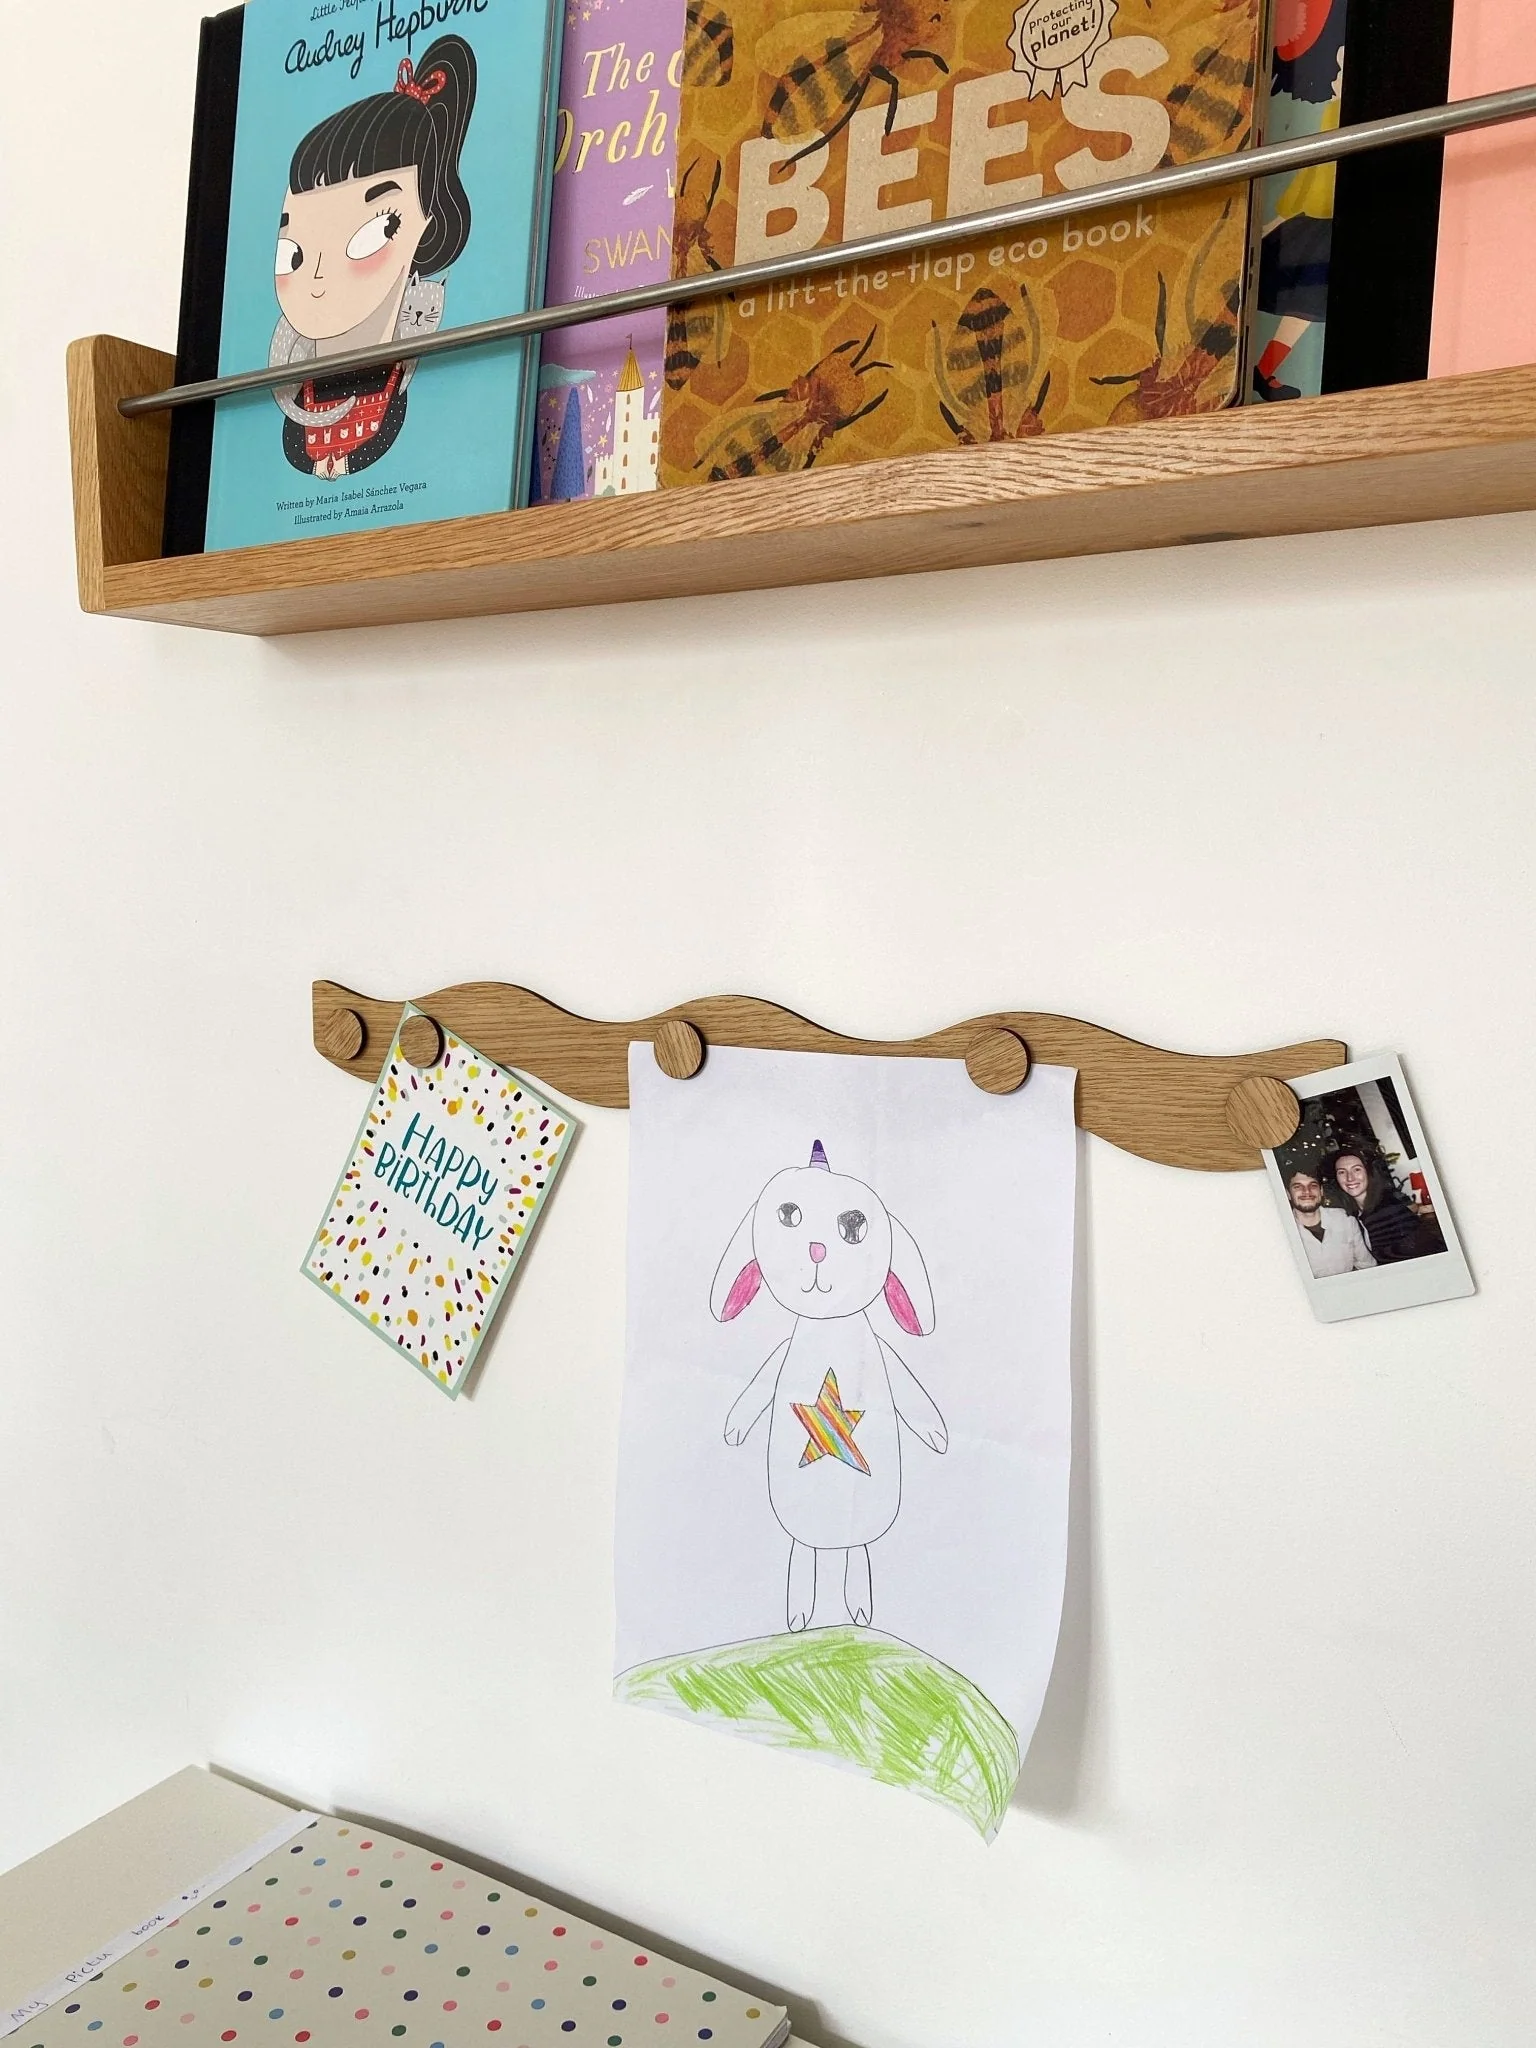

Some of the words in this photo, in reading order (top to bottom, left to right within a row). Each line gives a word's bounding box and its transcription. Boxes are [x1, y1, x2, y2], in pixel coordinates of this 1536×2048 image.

[309, 3, 338, 21] Little
[1029, 0, 1093, 34] protecting
[1030, 9, 1096, 61] planet!
[1051, 16, 1072, 31] our
[284, 29, 365, 79] Audrey
[375, 0, 489, 55] Hepburn
[581, 42, 655, 98] The
[733, 35, 1170, 266] BEES
[738, 297, 756, 318] a
[988, 237, 1048, 267] eco
[1062, 203, 1153, 252] book
[275, 500, 304, 512] Written
[305, 497, 315, 508] by
[316, 494, 339, 506] Maria
[341, 488, 364, 502] Isabel
[365, 484, 398, 498] Sánchez
[399, 480, 427, 493] Vegara
[293, 510, 332, 525] Illustrated
[333, 508, 343, 520] by
[344, 504, 369, 518] Amaia
[370, 499, 404, 515] Arrazola
[11, 2001, 49, 2023] My
[131, 1915, 166, 1936] book
